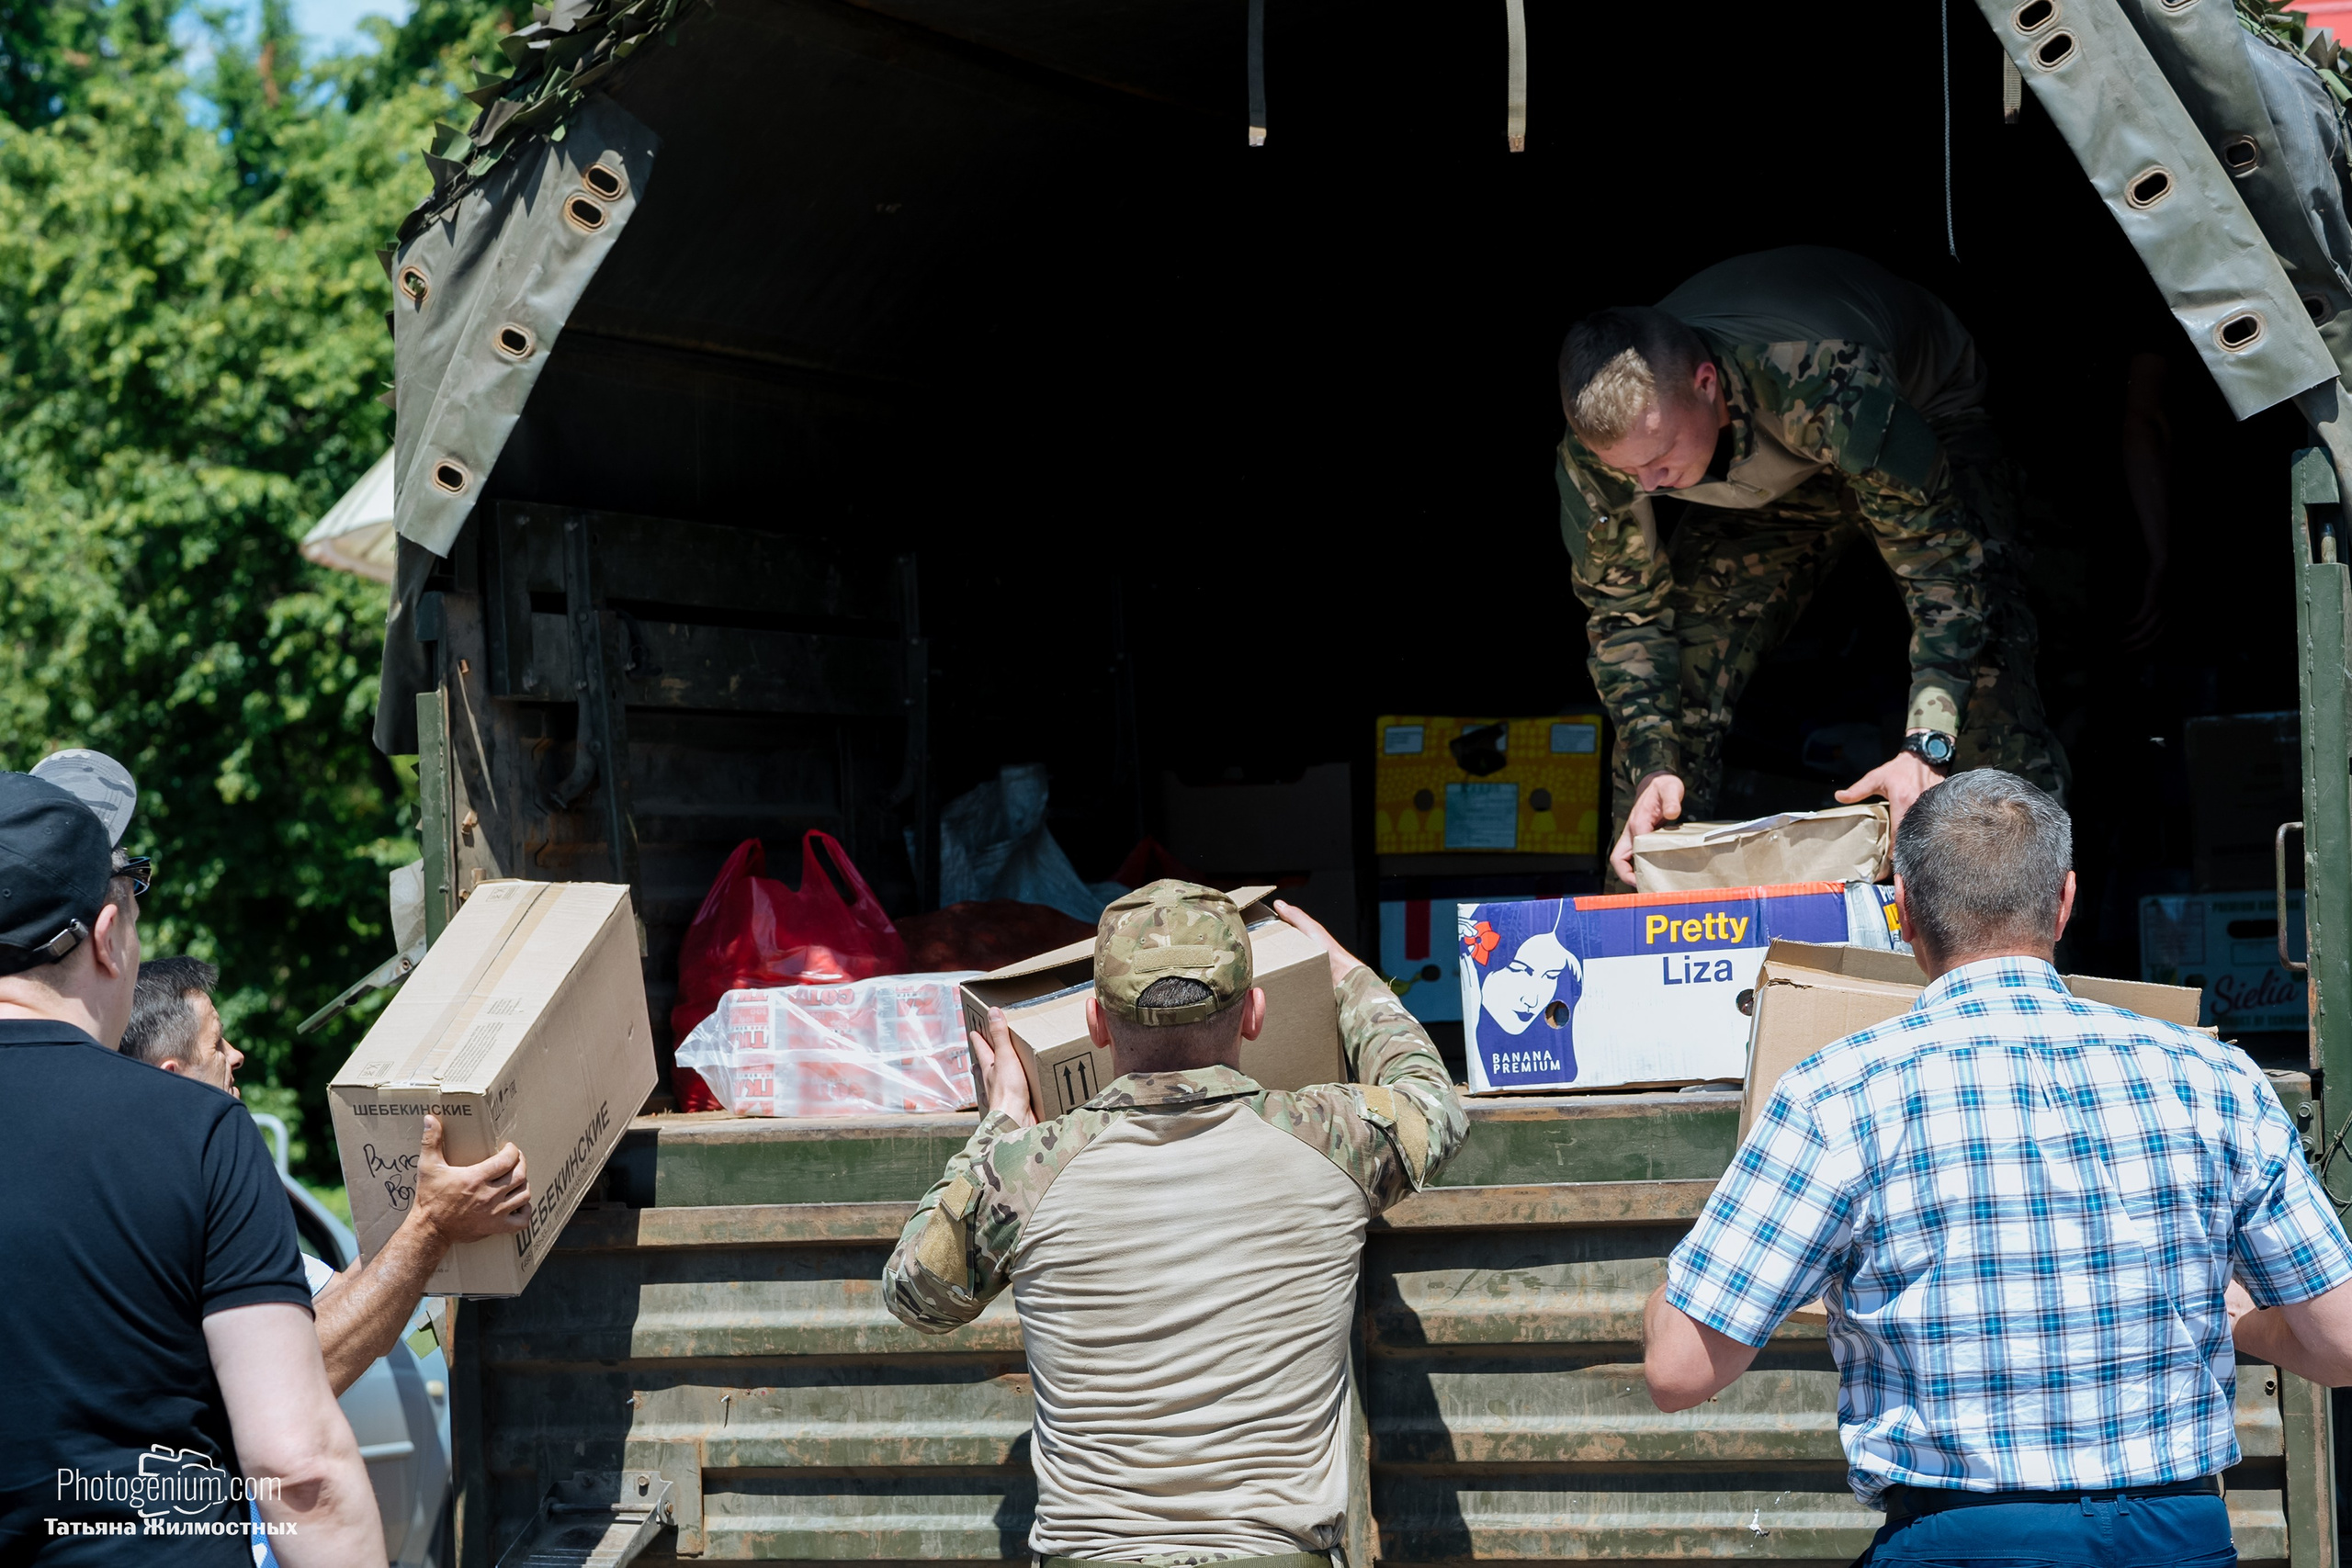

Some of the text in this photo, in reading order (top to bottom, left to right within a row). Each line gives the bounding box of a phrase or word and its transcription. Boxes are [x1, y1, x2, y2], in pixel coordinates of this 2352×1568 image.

[1645, 911, 1748, 944] Pretty
[1663, 955, 1733, 985] Liza
[2210, 968, 2299, 1016] Sielia
[1492, 1050, 1553, 1064] BANANA
[1493, 1059, 1561, 1075] PREMIUM
[353, 1104, 472, 1116] ШЕБЕКИНСКИЕ
[515, 1100, 610, 1258] ШЕБЕКИНСКИЕ
